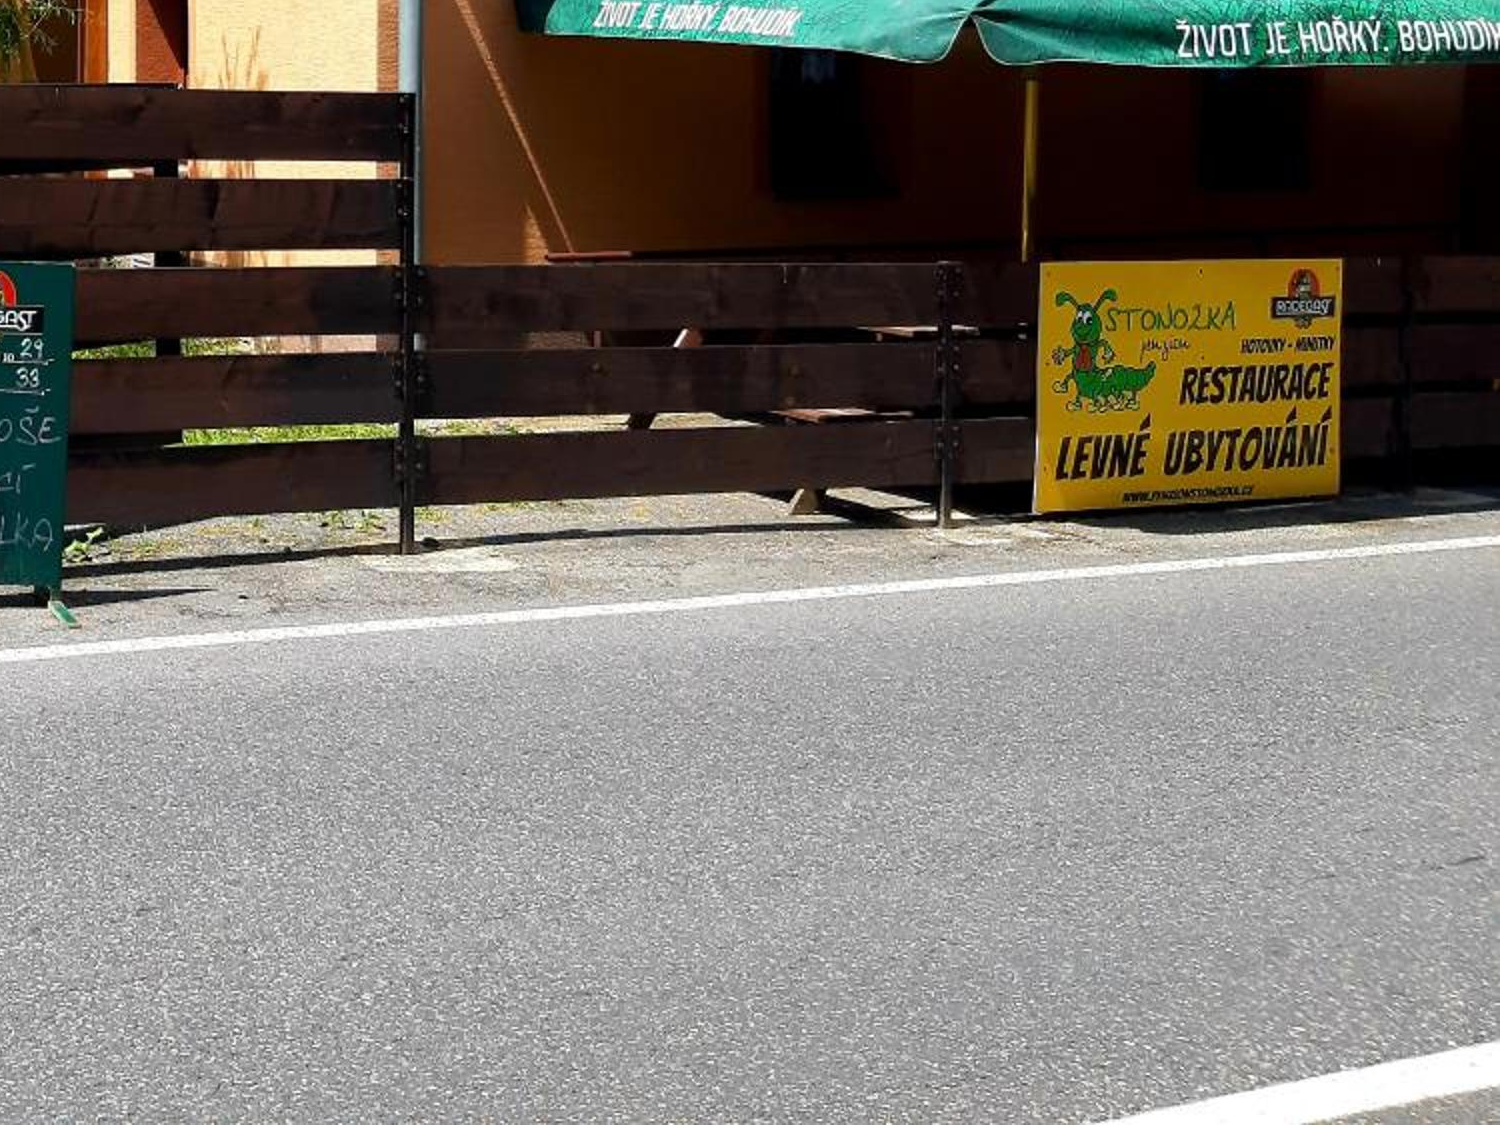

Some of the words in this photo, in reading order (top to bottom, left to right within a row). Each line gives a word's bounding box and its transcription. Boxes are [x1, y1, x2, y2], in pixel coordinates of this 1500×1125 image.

[638, 2, 662, 30] JE
[1176, 18, 1252, 59] ŽIVOT
[1266, 21, 1291, 55] JE
[1299, 15, 1390, 54] HOŘKÝ.
[1275, 298, 1333, 316] RADEGAST
[1179, 362, 1335, 406] RESTAURACE
[1056, 412, 1151, 481] LEVNÉ
[1163, 406, 1333, 475] UBYTOVÁNÍ
